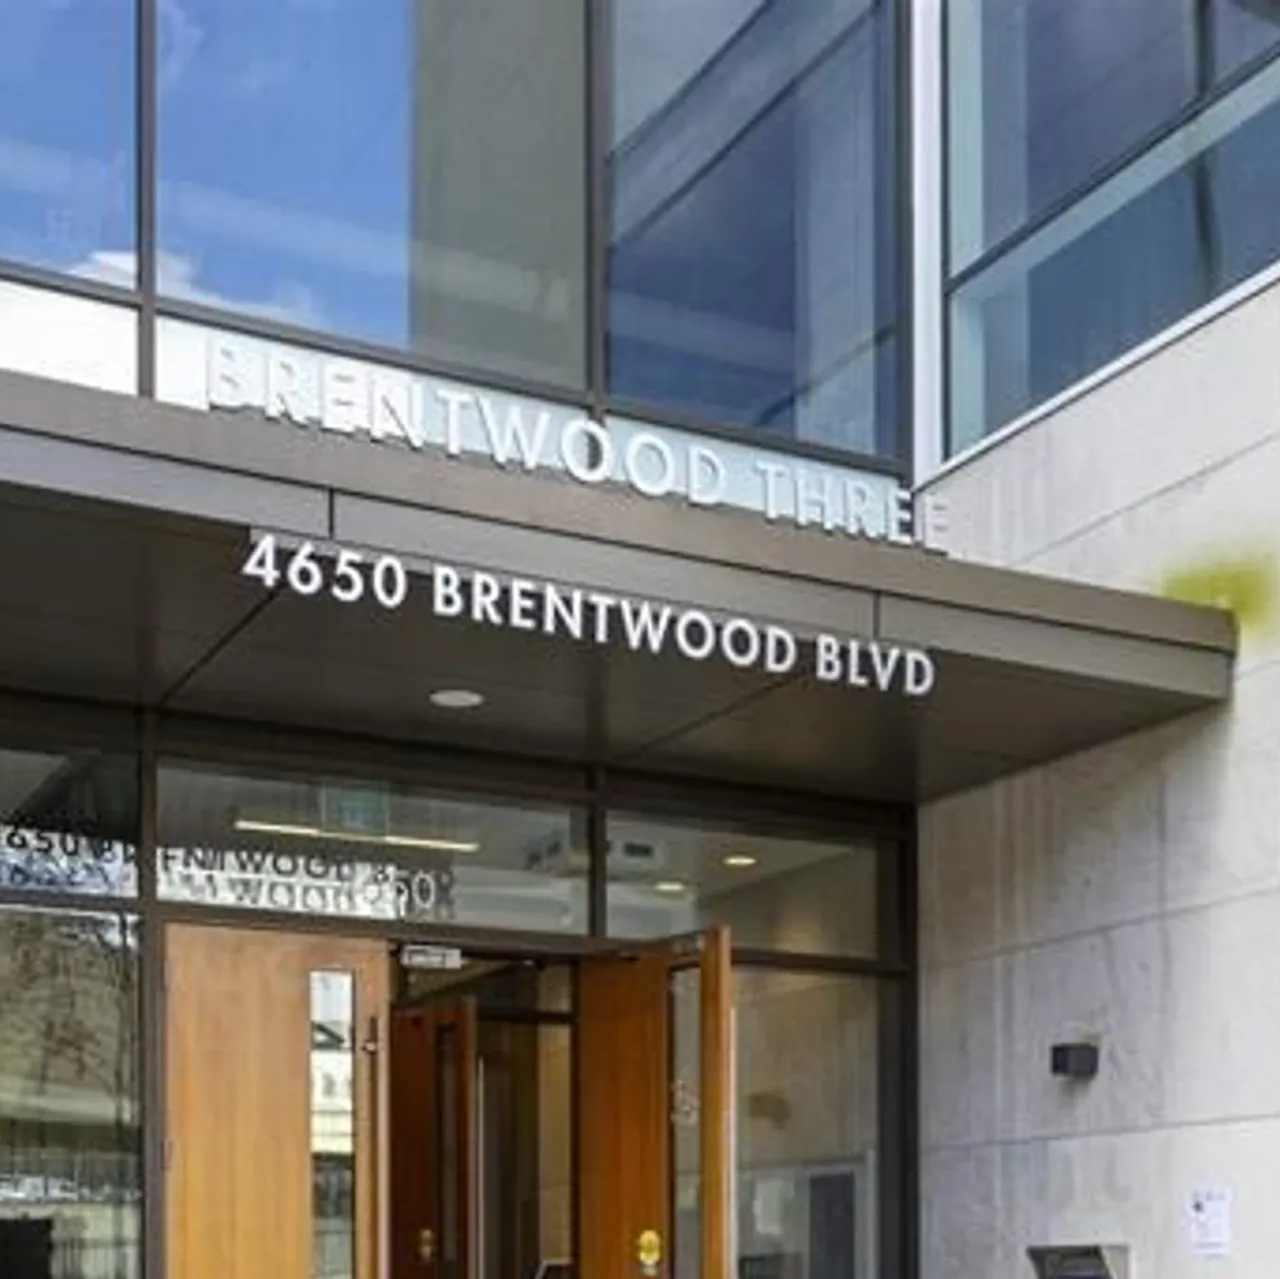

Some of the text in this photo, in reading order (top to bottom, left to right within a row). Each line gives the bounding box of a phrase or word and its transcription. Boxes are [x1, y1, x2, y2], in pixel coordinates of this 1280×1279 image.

[210, 340, 949, 557] BRENTWOOD THREE
[242, 534, 935, 696] 4650 BRENTWOOD BLVD
